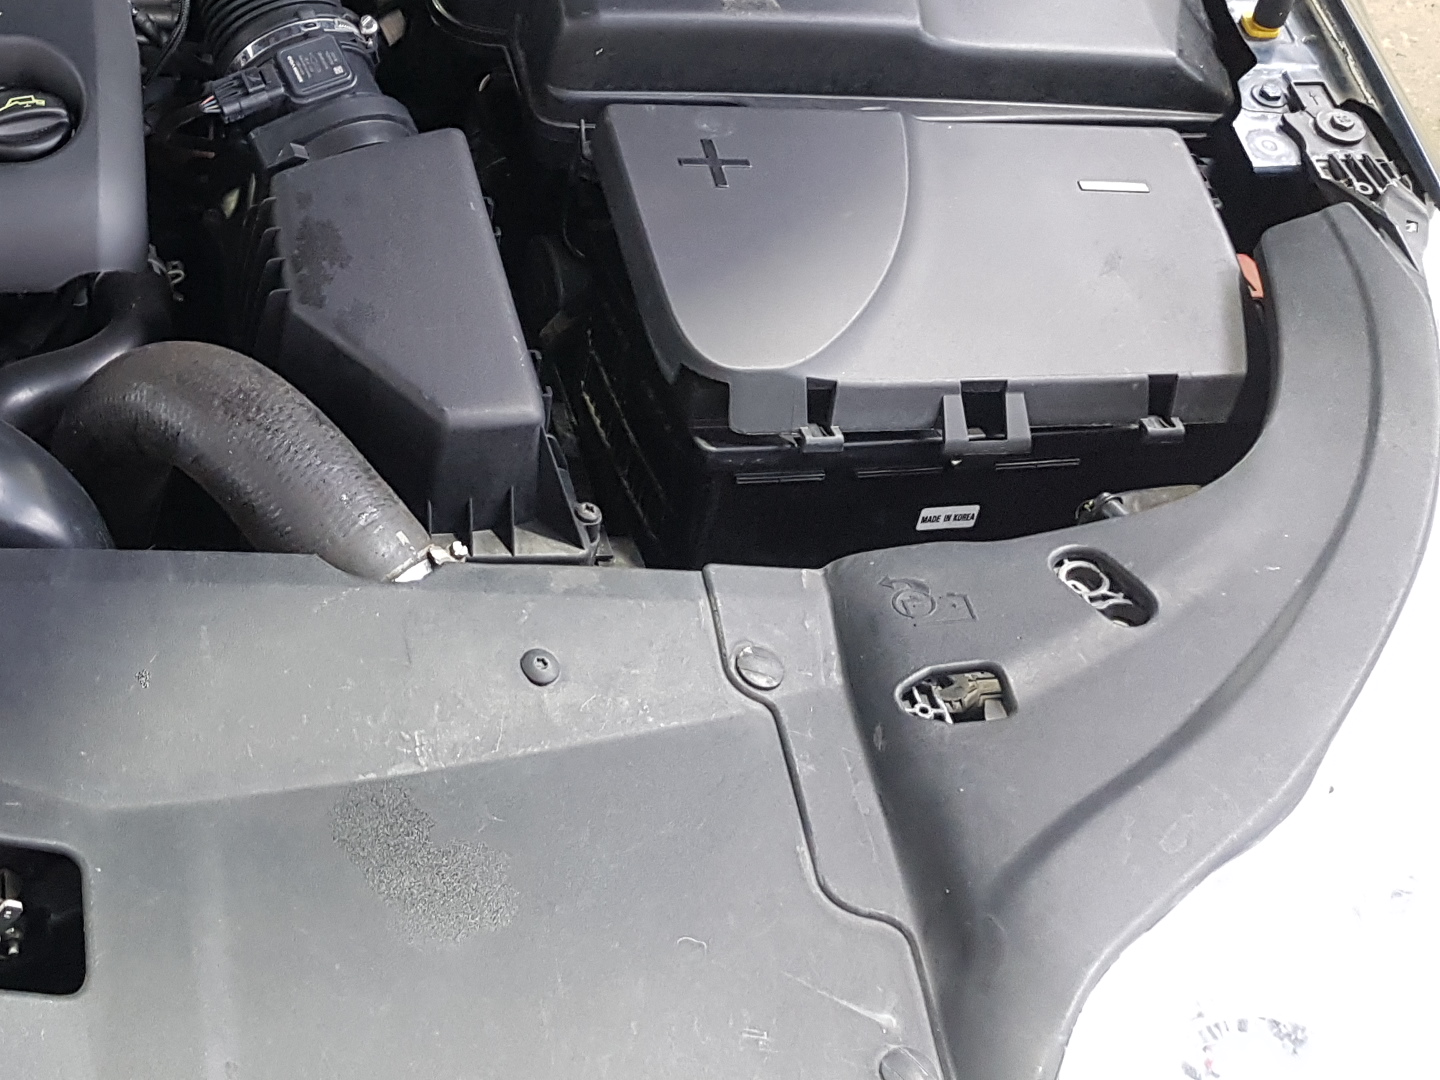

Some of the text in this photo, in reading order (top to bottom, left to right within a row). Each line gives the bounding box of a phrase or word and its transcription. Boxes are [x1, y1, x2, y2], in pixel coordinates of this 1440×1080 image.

[920, 512, 976, 524] MADE IN KOREA
